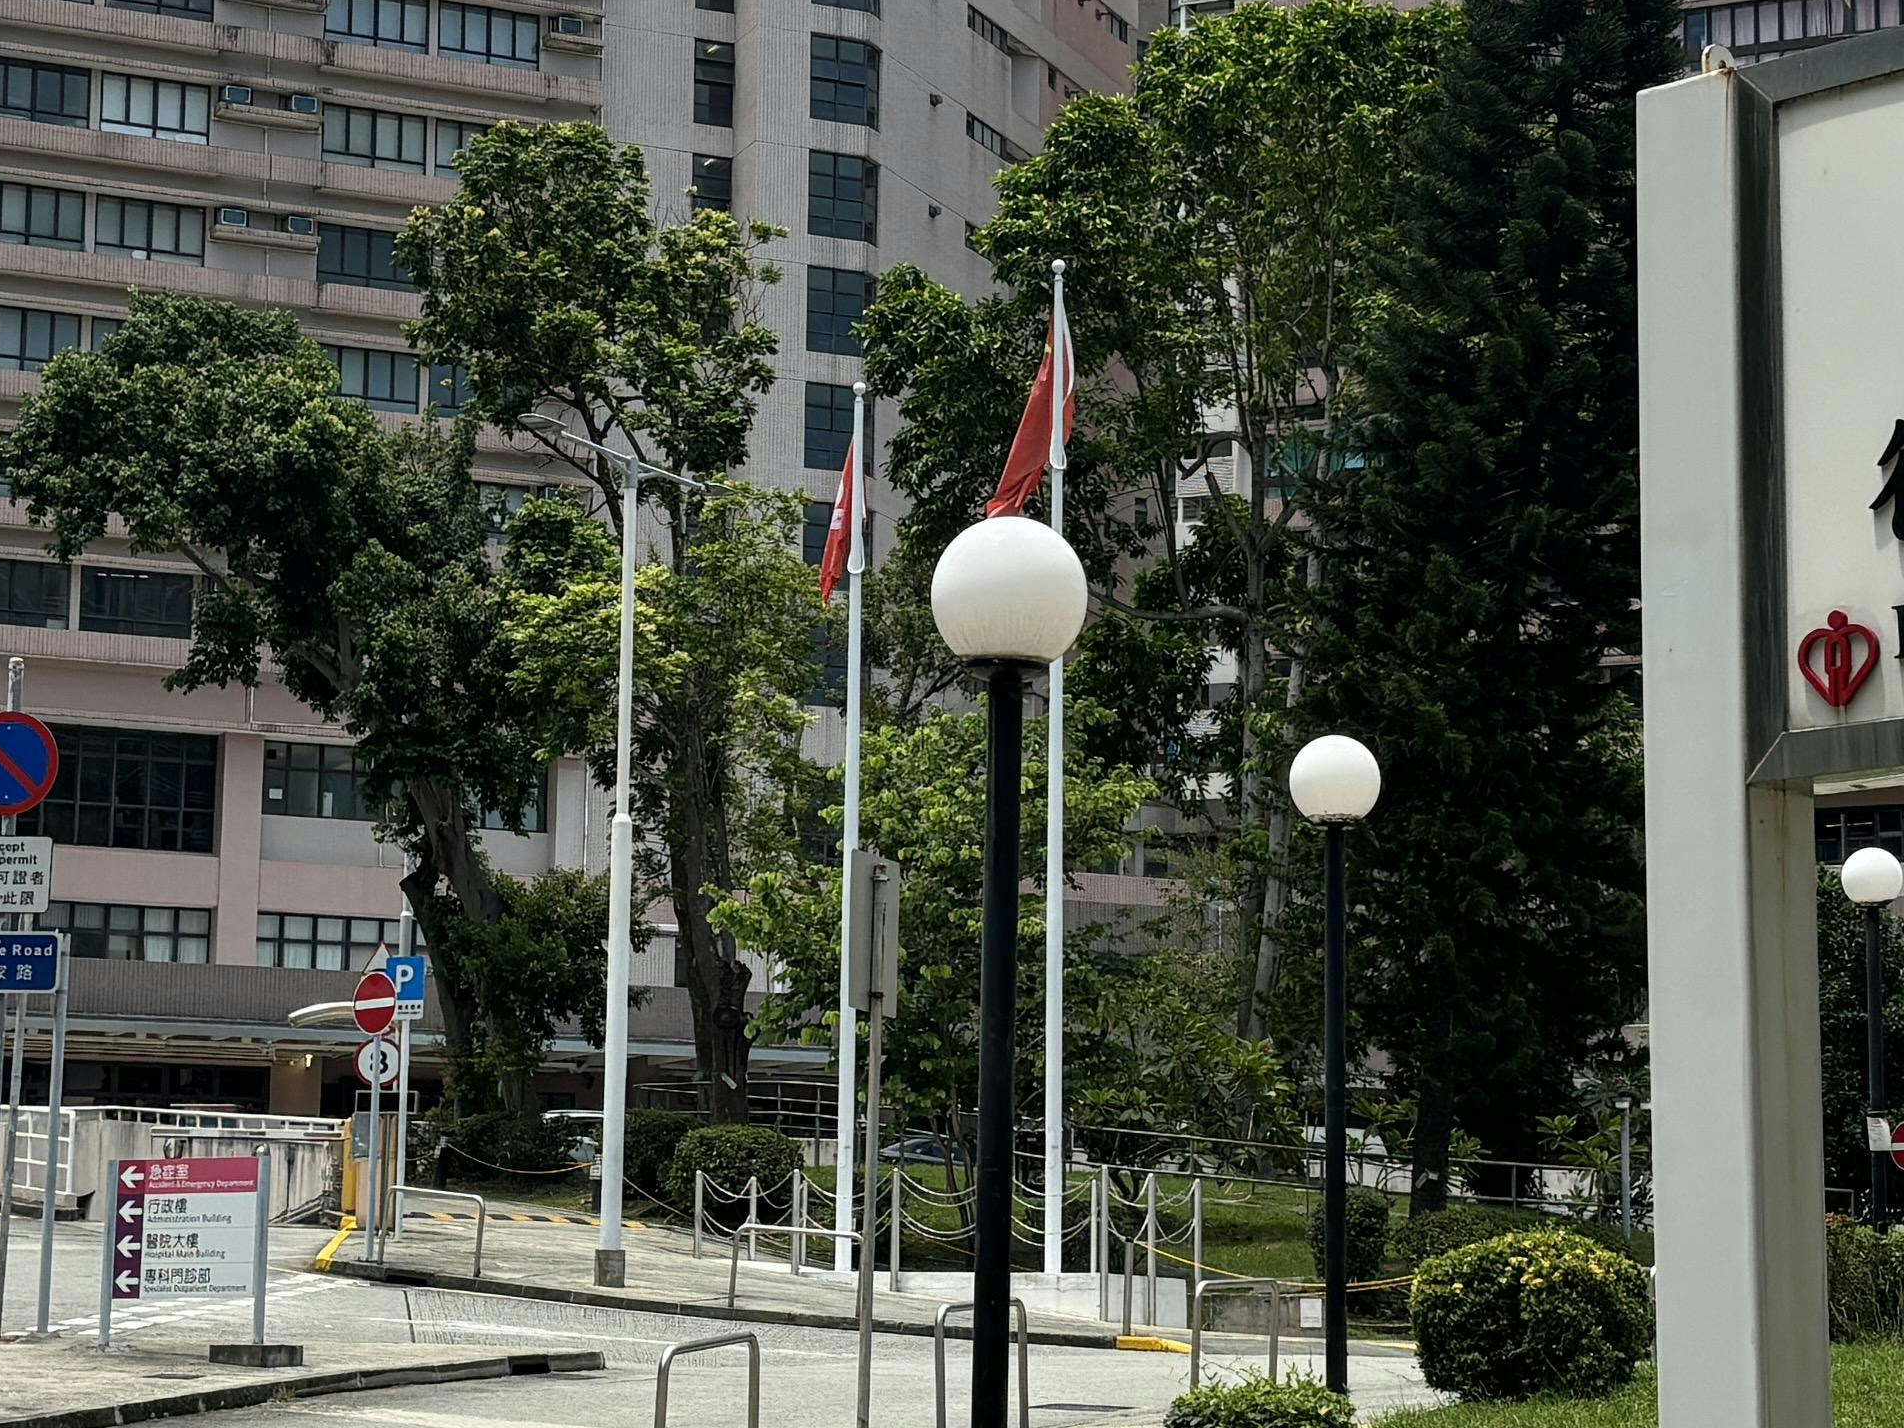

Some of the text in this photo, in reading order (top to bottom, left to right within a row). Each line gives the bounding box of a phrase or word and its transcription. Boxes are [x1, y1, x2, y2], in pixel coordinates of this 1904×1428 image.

[12, 943, 53, 956] Road
[396, 964, 414, 993] P
[148, 1164, 189, 1180] 急症室
[148, 1180, 176, 1188] Accident
[182, 1180, 215, 1189] Emergency
[216, 1179, 254, 1188] Department
[148, 1198, 188, 1214] 行政樓
[147, 1214, 232, 1224] Administration Building
[146, 1233, 199, 1249] 醫院大樓
[144, 1249, 226, 1259] Hospital Main Building
[144, 1268, 211, 1284] 專科門診部
[209, 1284, 247, 1292] Department
